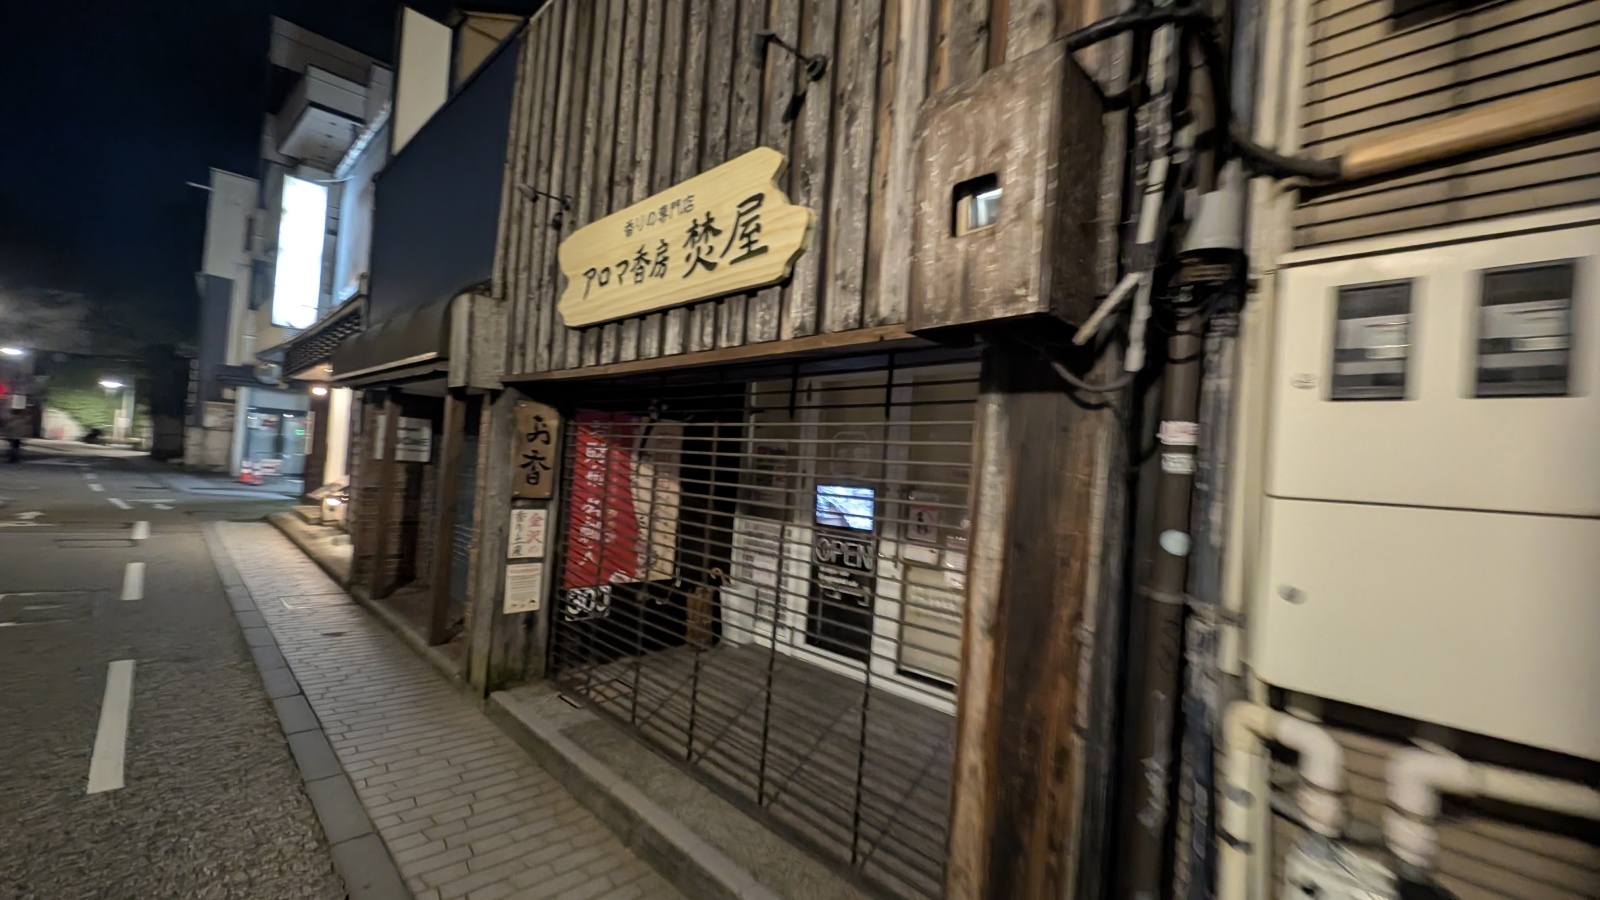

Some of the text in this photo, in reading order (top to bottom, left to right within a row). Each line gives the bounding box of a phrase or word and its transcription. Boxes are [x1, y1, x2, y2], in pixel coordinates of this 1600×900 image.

[624, 195, 696, 238] 香りの専門店
[582, 192, 769, 300] アロマ香房 焚屋
[519, 414, 552, 486] お香
[815, 538, 873, 570] OPEN
